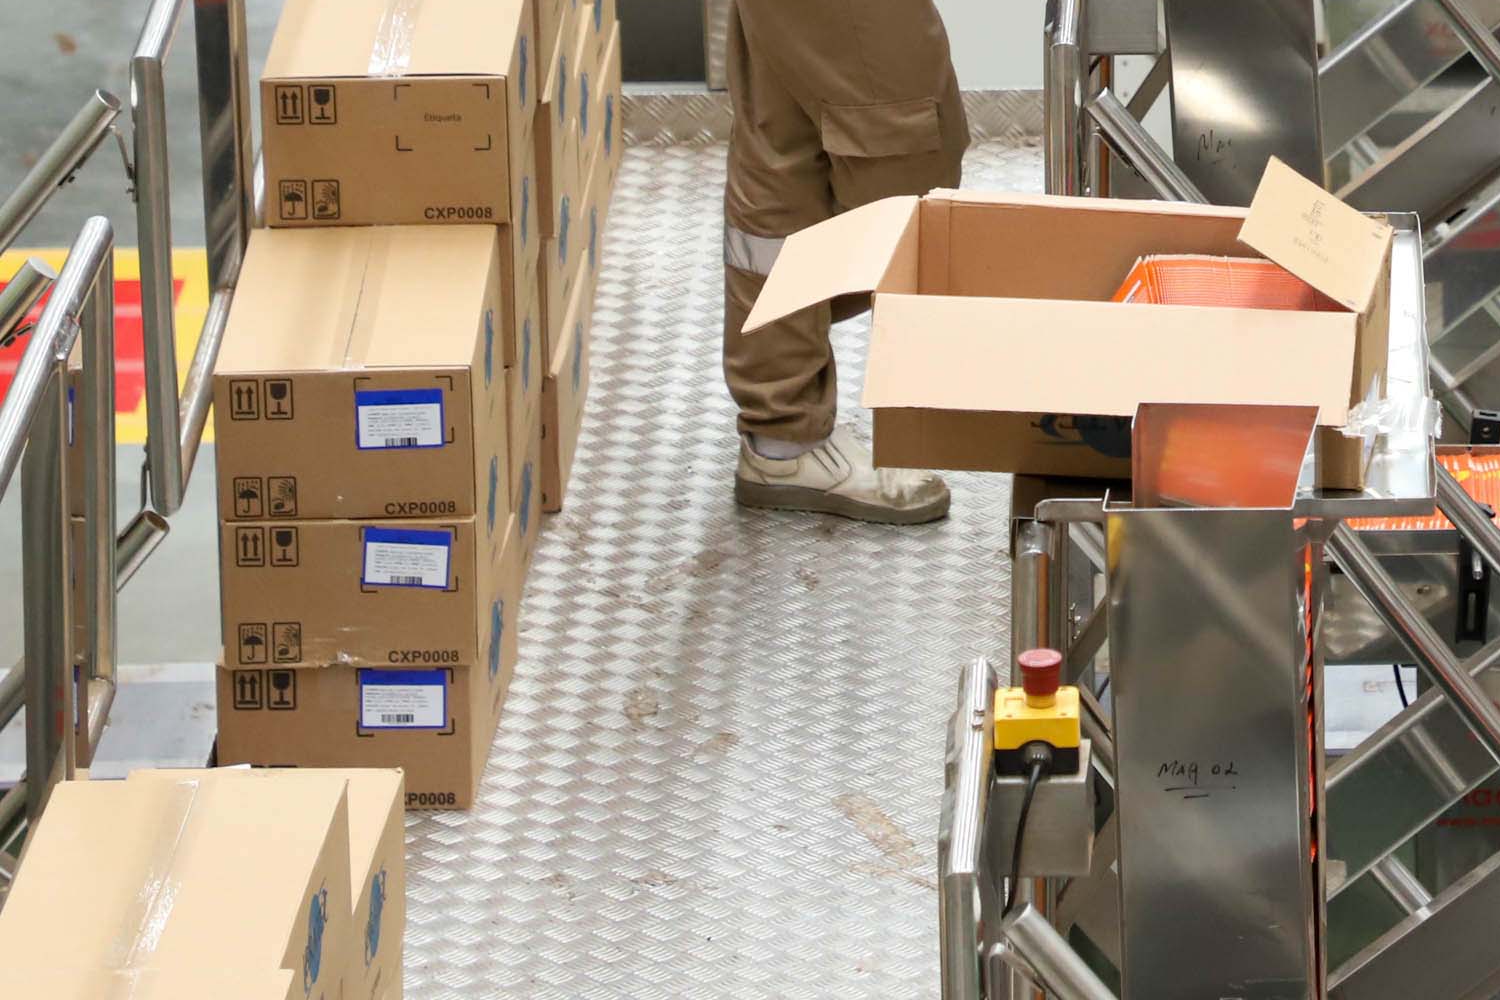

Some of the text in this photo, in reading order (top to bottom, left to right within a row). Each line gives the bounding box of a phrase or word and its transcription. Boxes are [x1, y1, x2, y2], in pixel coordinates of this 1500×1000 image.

[424, 113, 462, 124] Etiqueta
[424, 207, 493, 220] CXP0008
[384, 501, 456, 515] CXP0008
[388, 650, 459, 664] CXP0008
[404, 792, 456, 806] P0008
